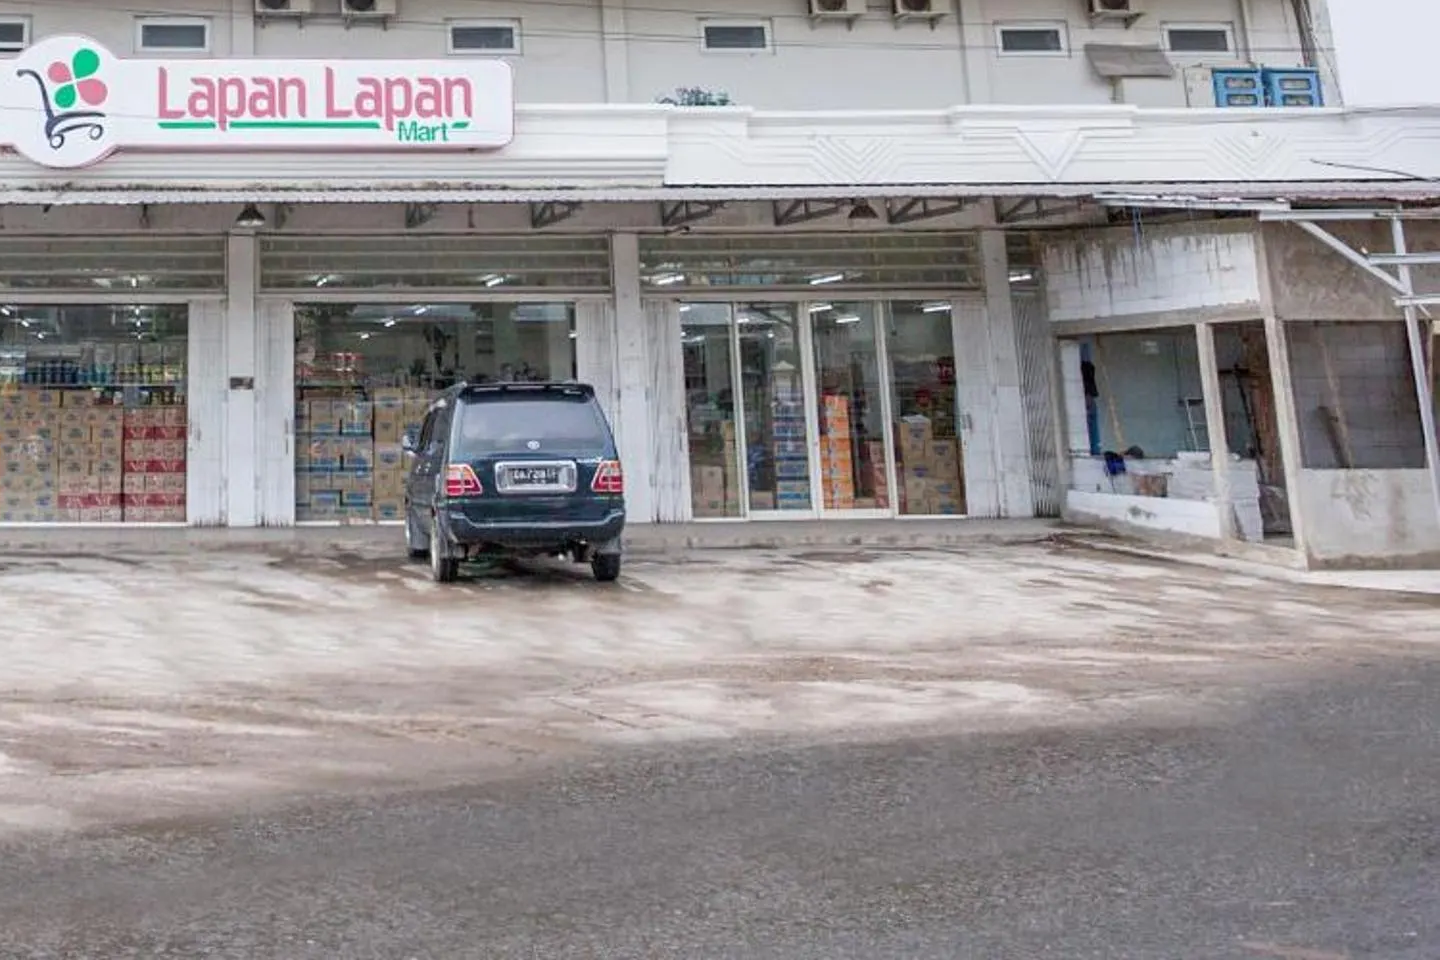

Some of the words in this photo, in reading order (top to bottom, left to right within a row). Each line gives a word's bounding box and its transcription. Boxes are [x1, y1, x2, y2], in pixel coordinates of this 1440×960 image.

[158, 66, 307, 132] Lapan
[325, 66, 473, 132] Lapan
[397, 121, 449, 142] Mart
